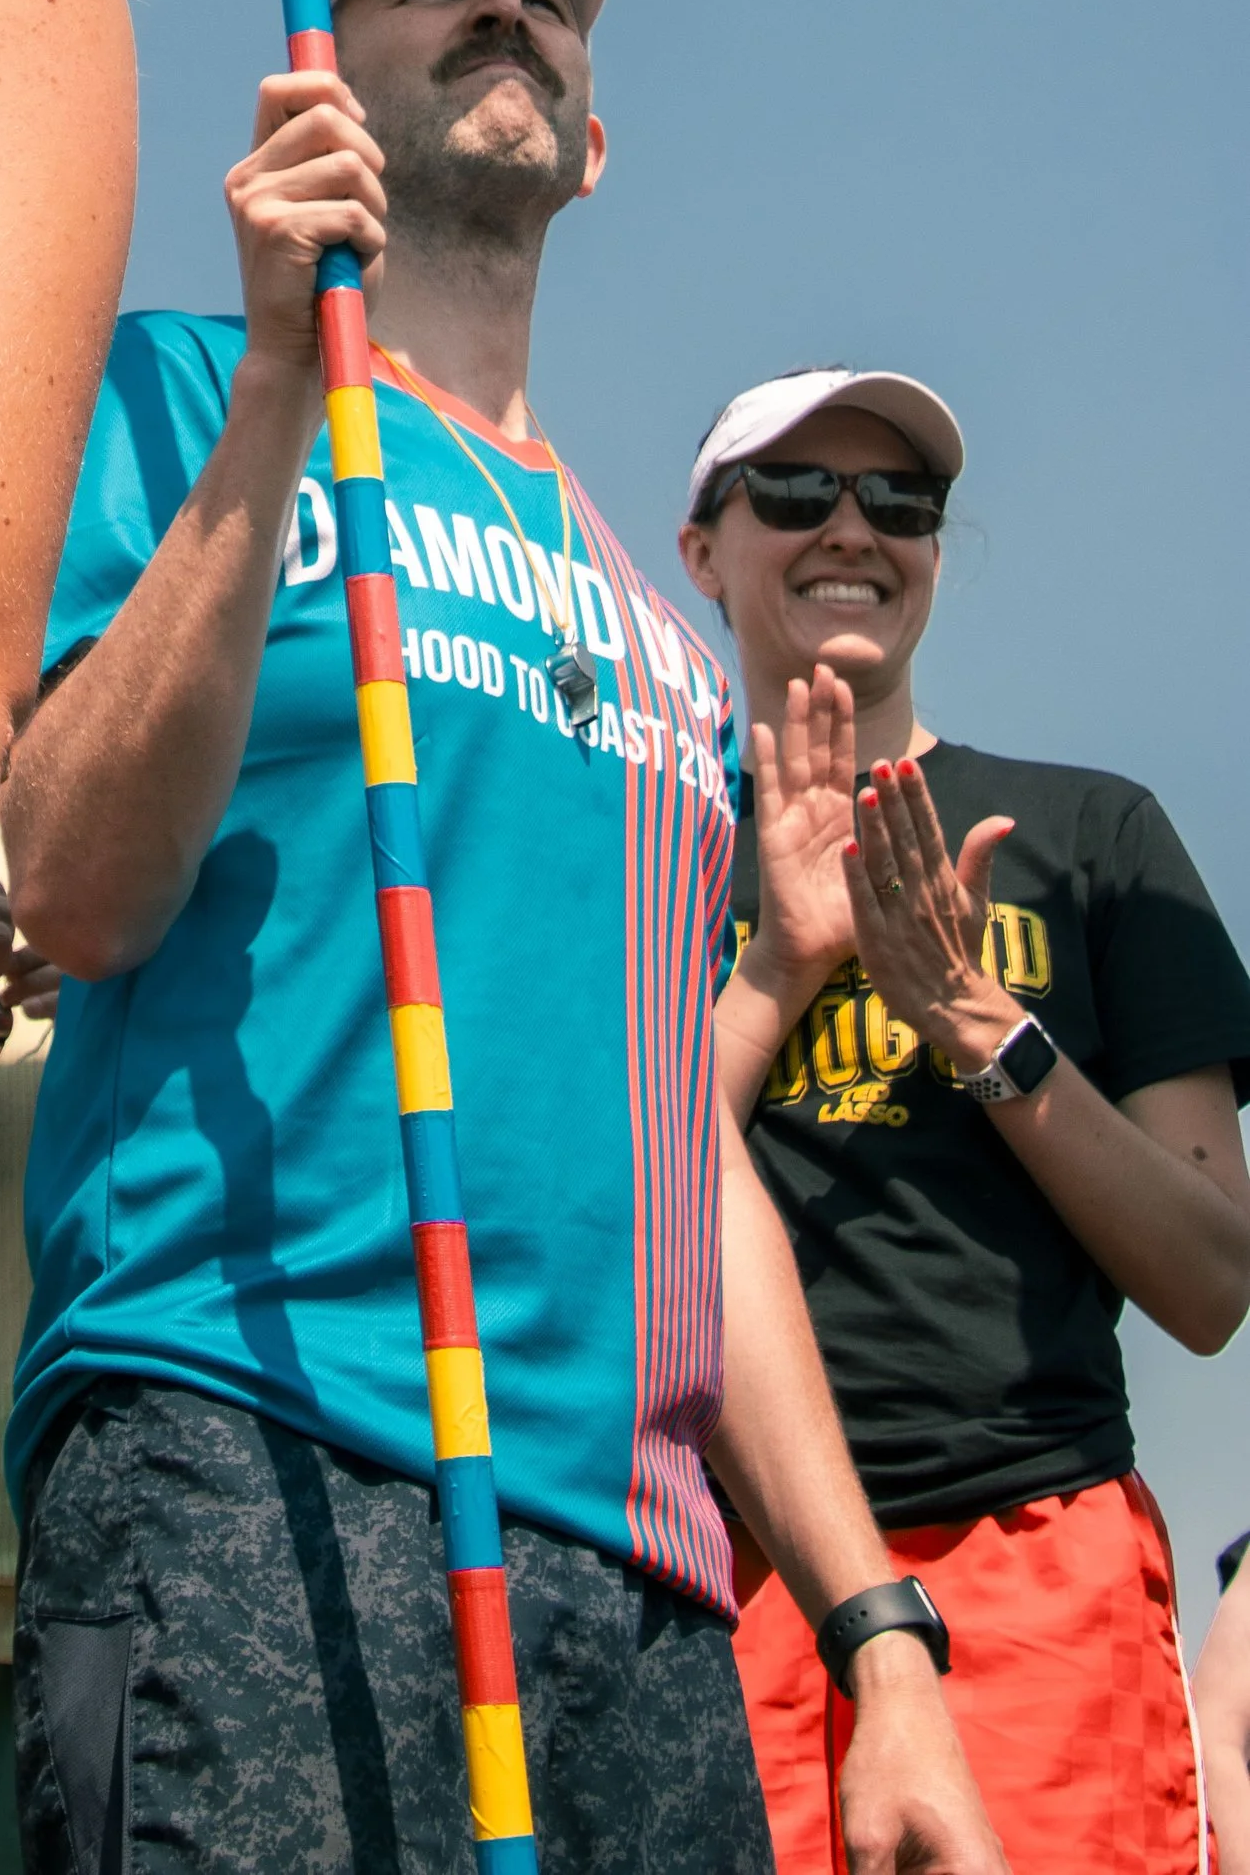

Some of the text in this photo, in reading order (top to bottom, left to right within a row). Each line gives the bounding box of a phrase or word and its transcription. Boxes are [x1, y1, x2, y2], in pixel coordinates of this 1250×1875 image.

[283, 475, 628, 662] DAMOND
[401, 627, 506, 699] HOOD
[509, 655, 549, 725] TO
[817, 1100, 910, 1128] LASSO
[839, 1081, 892, 1104] TED
